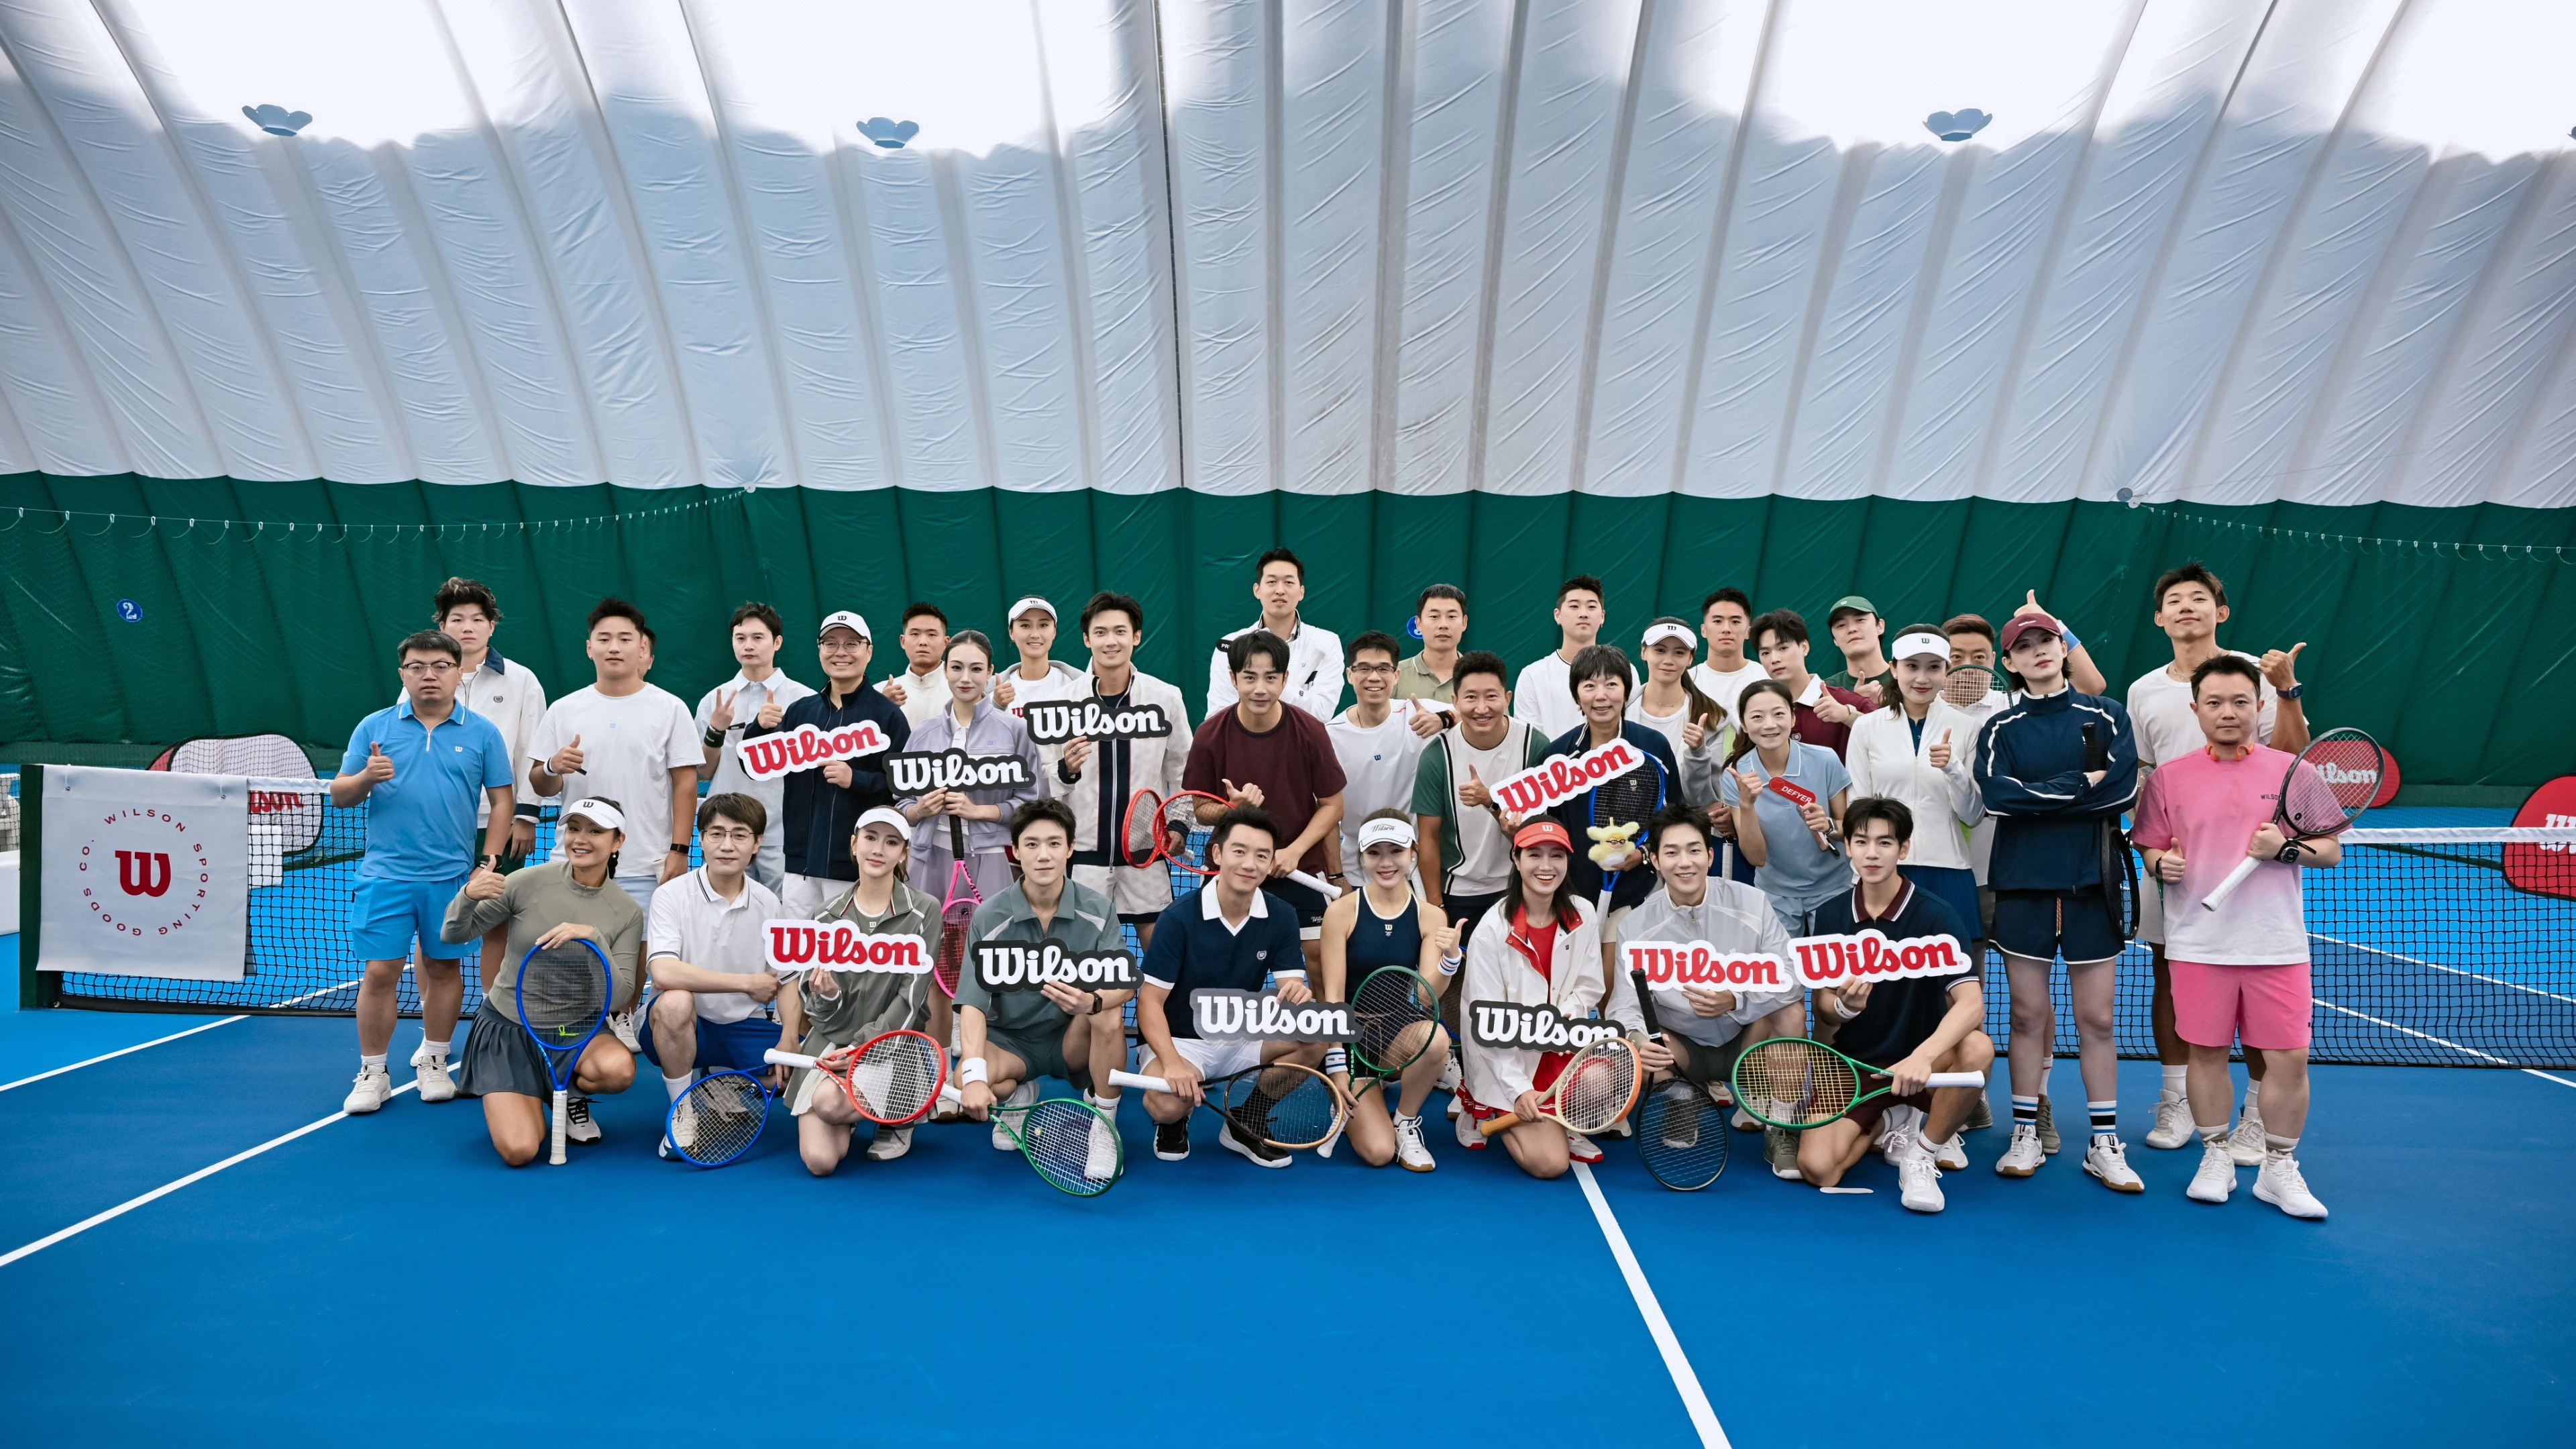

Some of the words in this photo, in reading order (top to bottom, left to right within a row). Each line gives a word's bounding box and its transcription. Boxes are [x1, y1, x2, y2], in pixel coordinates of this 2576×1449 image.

[123, 602, 137, 619] 2
[1030, 703, 1161, 739] Wilson
[745, 727, 879, 775] Wilson
[890, 755, 1025, 792] Wilson
[1498, 746, 1633, 814] Wilson
[1780, 786, 1813, 804] DEFYER
[104, 808, 186, 833] WILSON
[1371, 824, 1396, 833] Wilson
[79, 839, 94, 871] CO.
[115, 850, 172, 898] W
[158, 843, 209, 935] SPORTING
[83, 888, 142, 936] GOODS
[771, 926, 921, 966] Wilson
[979, 946, 1132, 985] Wilson
[1796, 936, 1958, 981] Wilson
[1626, 948, 1780, 984] Wilson
[1197, 996, 1350, 1035] Wilson
[1477, 1007, 1621, 1051] Wilson
